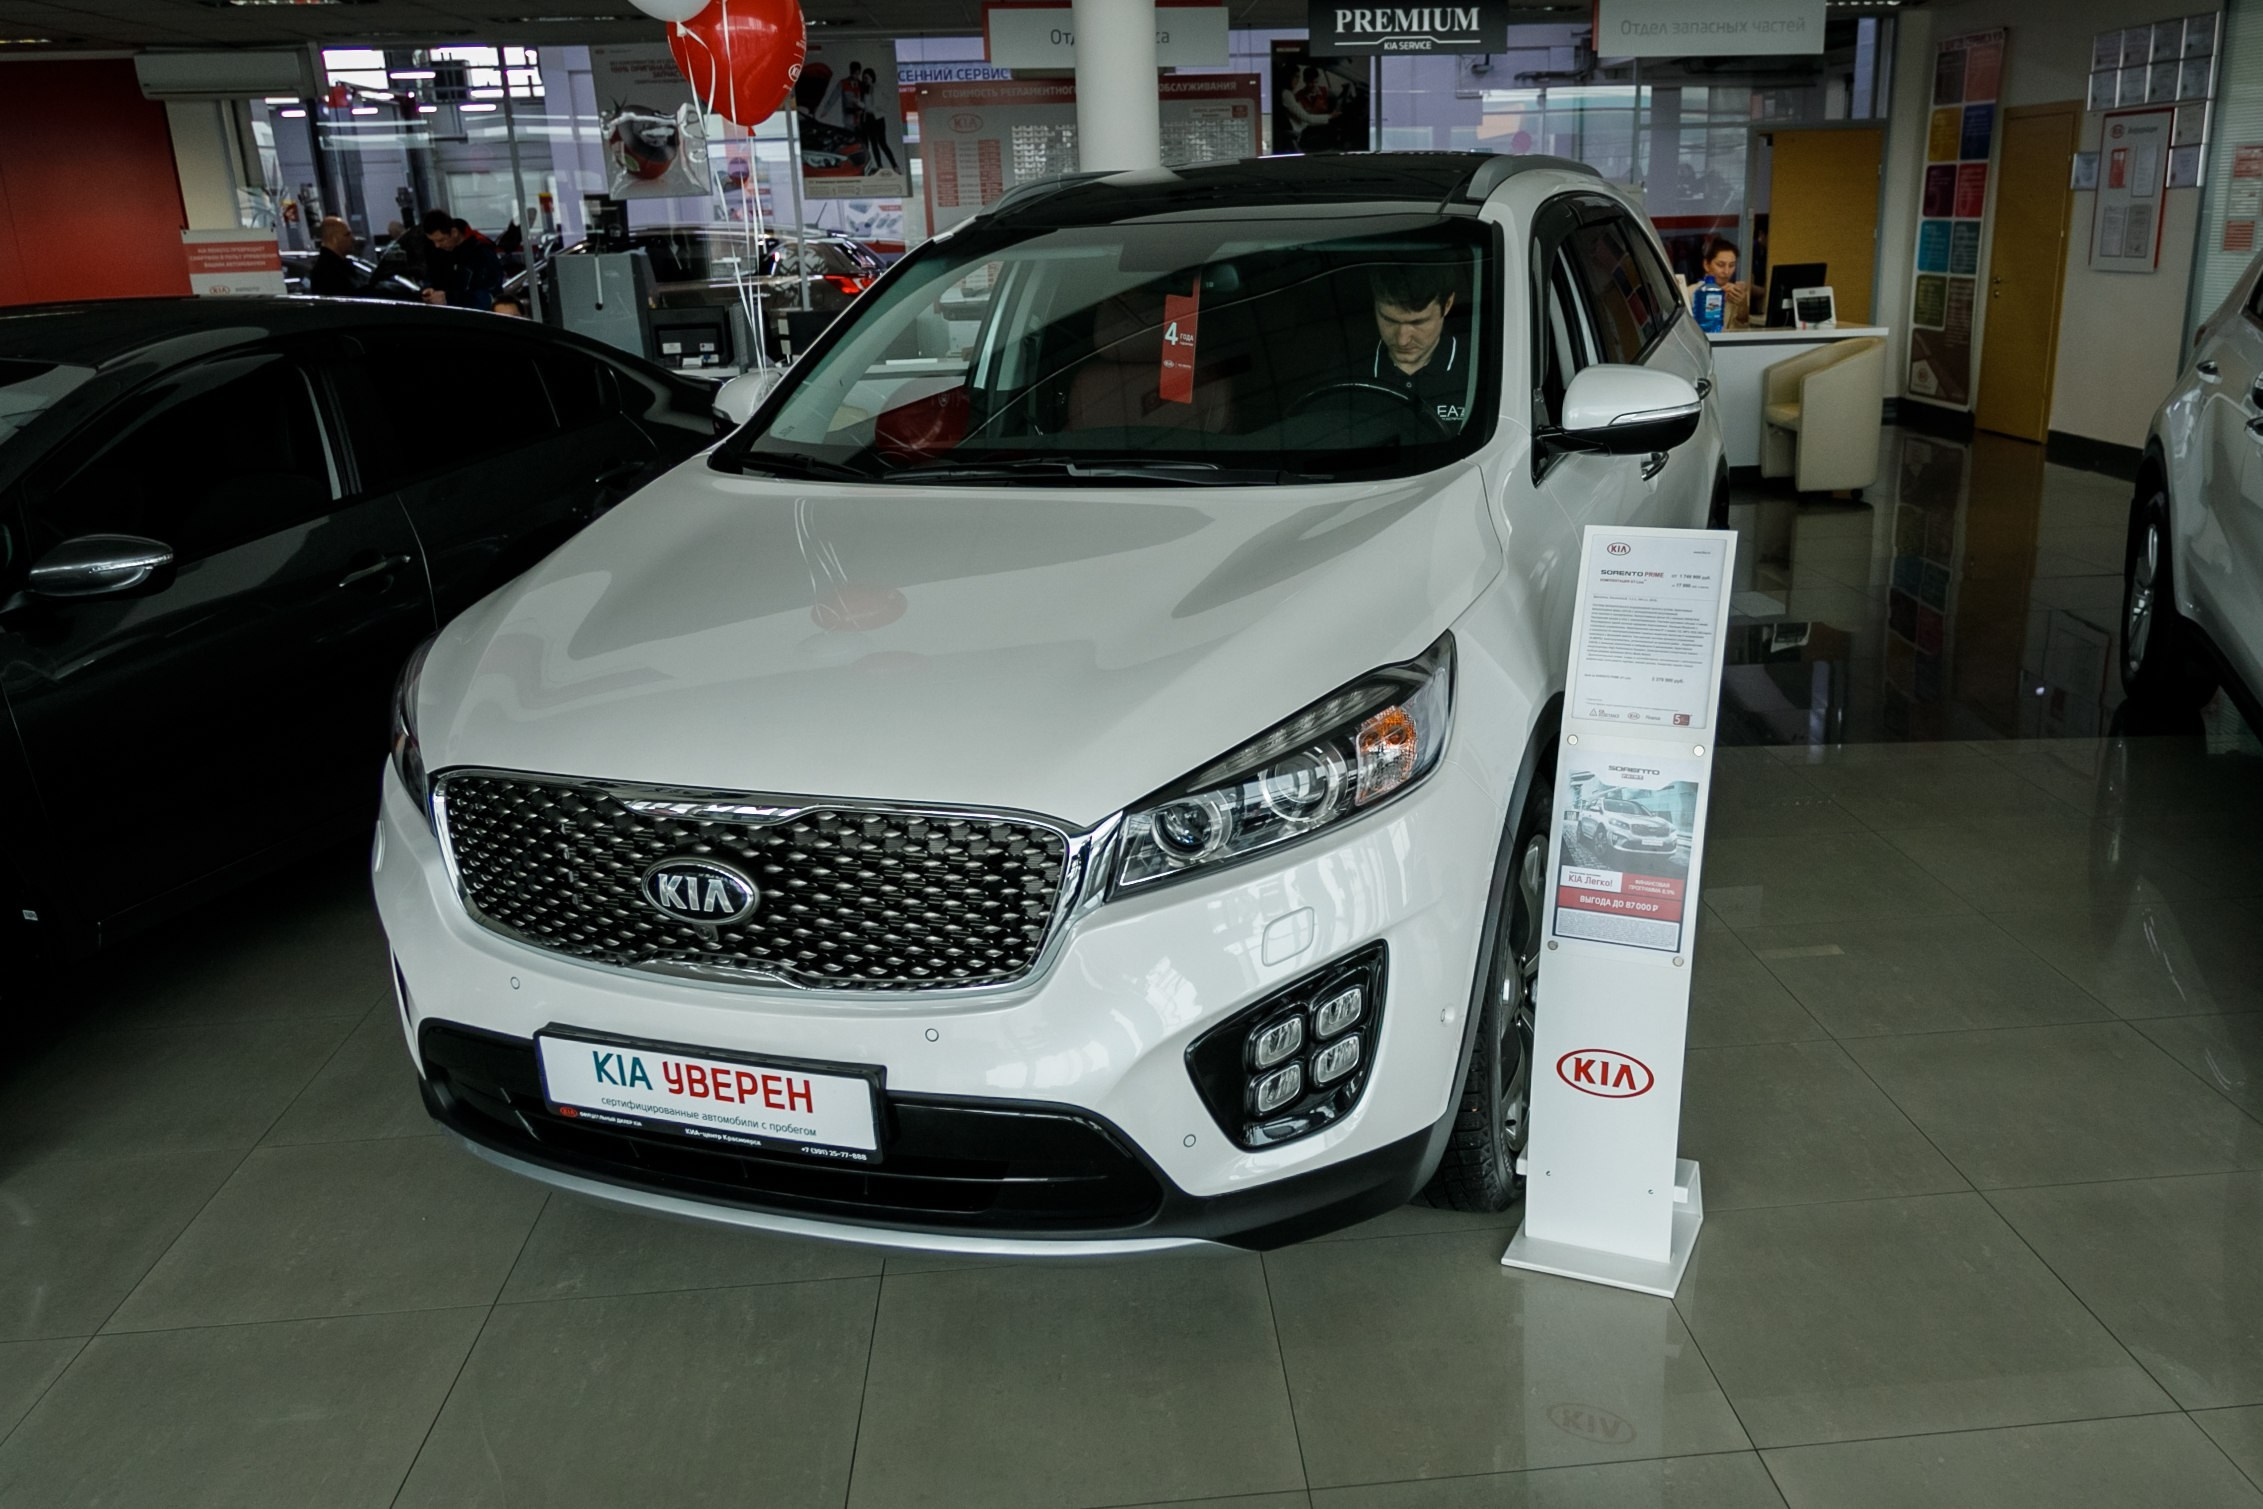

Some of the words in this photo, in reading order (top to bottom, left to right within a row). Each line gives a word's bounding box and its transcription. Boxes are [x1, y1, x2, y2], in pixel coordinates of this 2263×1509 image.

[1335, 7, 1480, 33] PREMIUM
[1620, 19, 1667, 36] Отдел
[1672, 20, 1748, 35] запасных
[1752, 17, 1806, 33] частей
[1384, 41, 1397, 50] KIA
[1399, 41, 1432, 50] SERVICE
[956, 68, 1009, 80] СЕРВИС
[1164, 321, 1179, 346] 4
[1600, 569, 1644, 577] SORENTO
[1608, 765, 1660, 776] SORENTO
[1568, 874, 1583, 884] KIA
[1584, 876, 1613, 888] Легко!
[658, 873, 735, 914] KIA
[1580, 894, 1611, 907] ВЫГОДА
[1612, 899, 1624, 909] ДО
[592, 1050, 654, 1091] KIA
[662, 1060, 814, 1114] УВЕРЕН
[1573, 1056, 1637, 1091] KIA
[601, 1096, 700, 1121] сертифицированные
[701, 1112, 760, 1129] автомобили
[761, 1121, 768, 1130] с
[769, 1121, 817, 1138] пробегом
